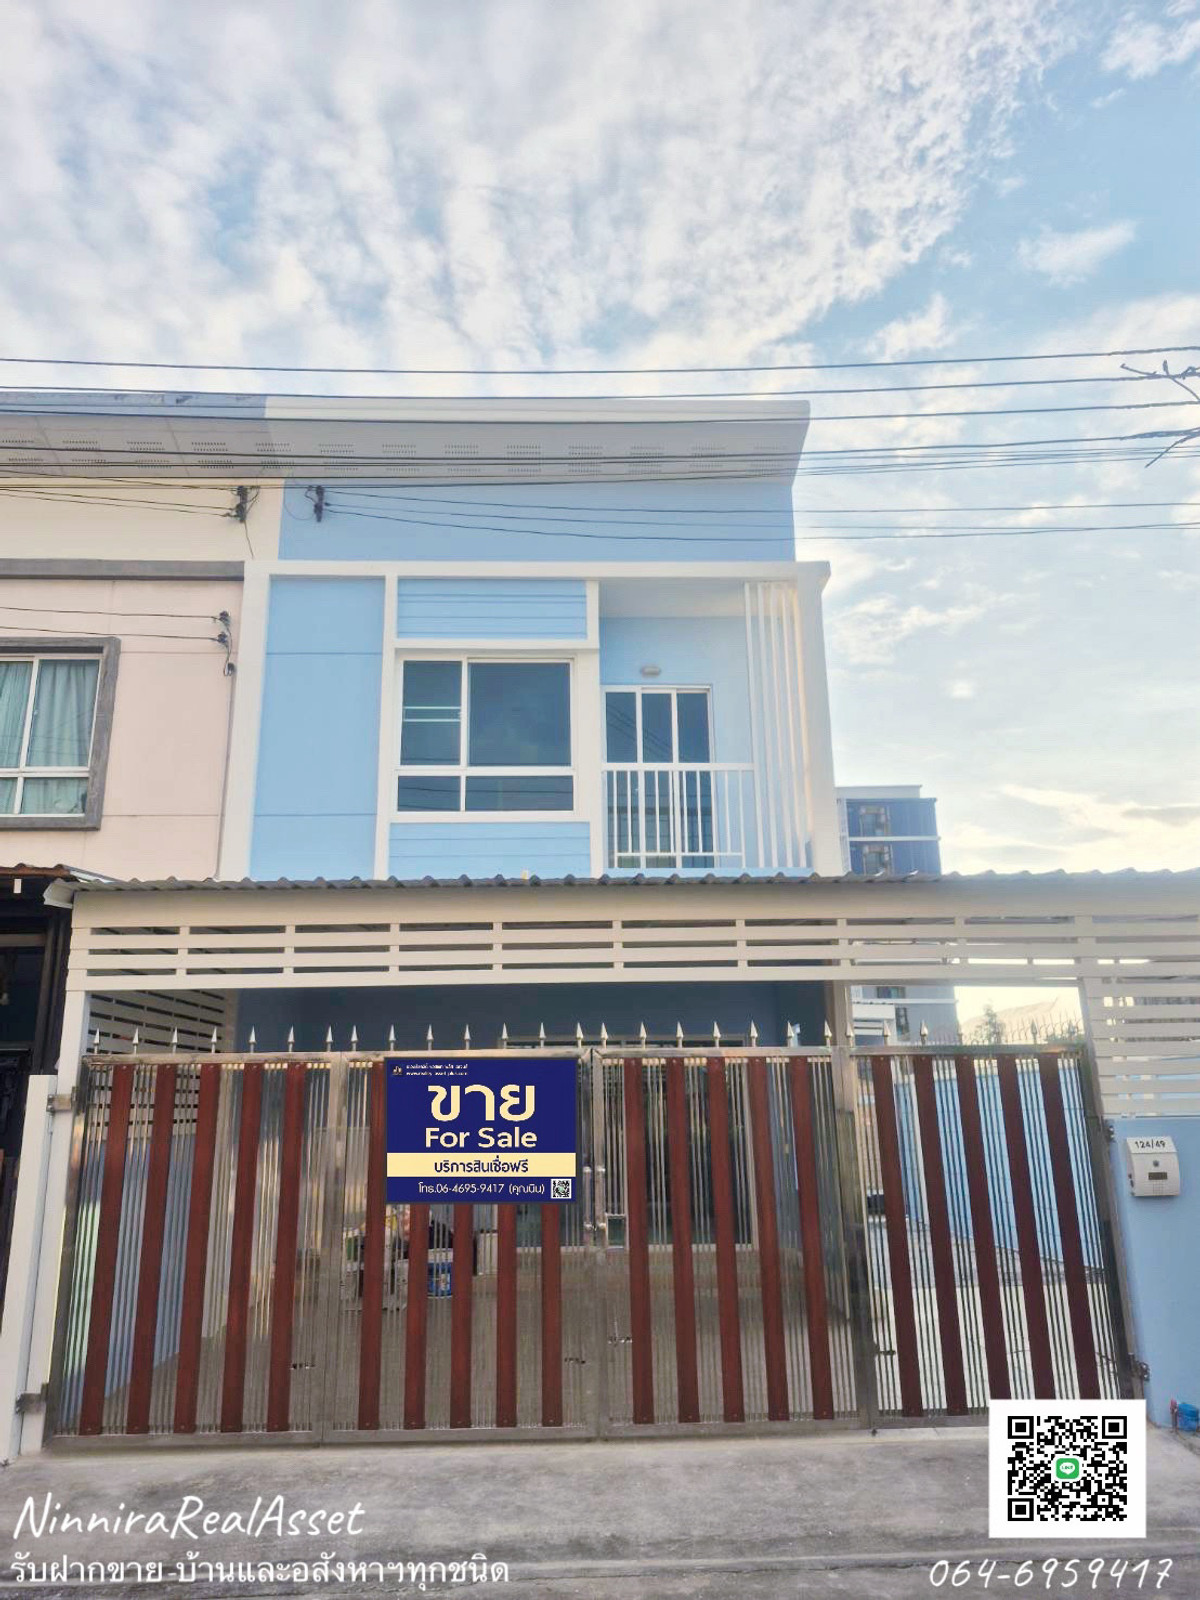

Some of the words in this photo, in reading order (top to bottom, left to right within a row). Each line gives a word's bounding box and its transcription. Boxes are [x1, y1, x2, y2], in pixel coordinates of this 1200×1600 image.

[427, 1084, 536, 1122] ขาย
[425, 1127, 470, 1148] For
[477, 1127, 538, 1148] Sale
[1134, 1139, 1166, 1149] 124/49
[434, 1155, 529, 1173] บริการสินเชื่อฟรี
[418, 1182, 505, 1193] โทร.06-4695-9417
